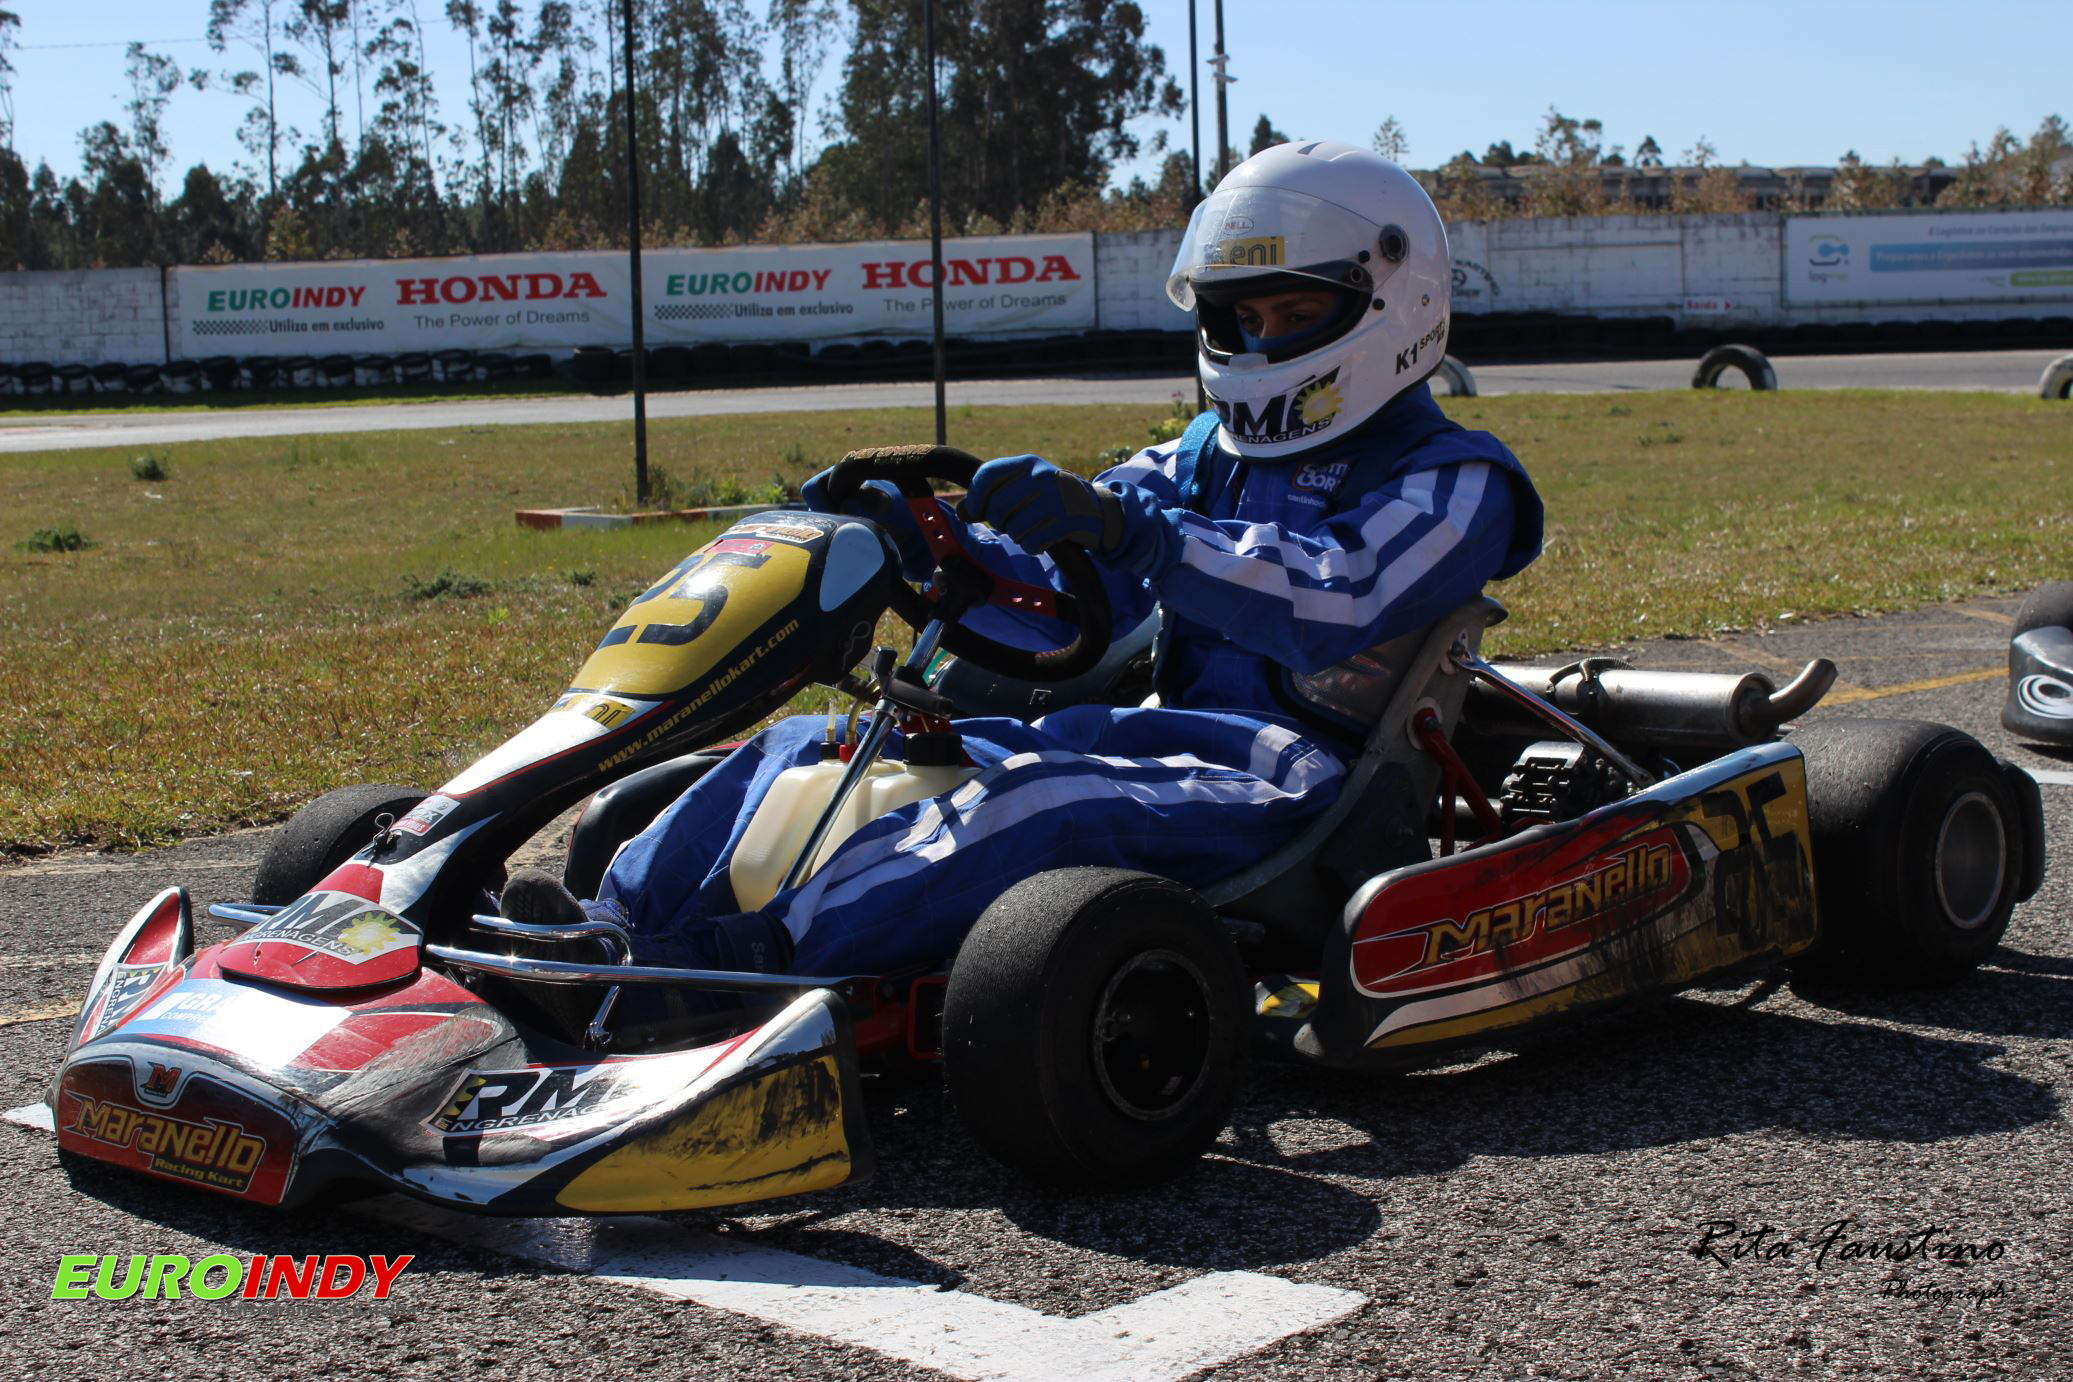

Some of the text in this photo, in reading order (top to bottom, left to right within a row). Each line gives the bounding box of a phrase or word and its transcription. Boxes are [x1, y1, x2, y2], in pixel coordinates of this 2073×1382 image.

[666, 269, 833, 296] EUROINDY
[862, 255, 1081, 290] HONDA
[207, 286, 366, 312] EUROINDY
[396, 272, 607, 305] HONDA
[734, 301, 854, 318] Utiliza em exclusivo
[884, 293, 1067, 314] The Pwer of Dreams
[269, 318, 385, 333] Utiliza em exclusivo
[414, 310, 591, 330] The Power of Dreams
[1396, 342, 1418, 375] K1
[598, 617, 800, 773] www.maranellokart.com
[70, 1097, 264, 1175] Maranello
[155, 1157, 245, 1188] Racing Kart
